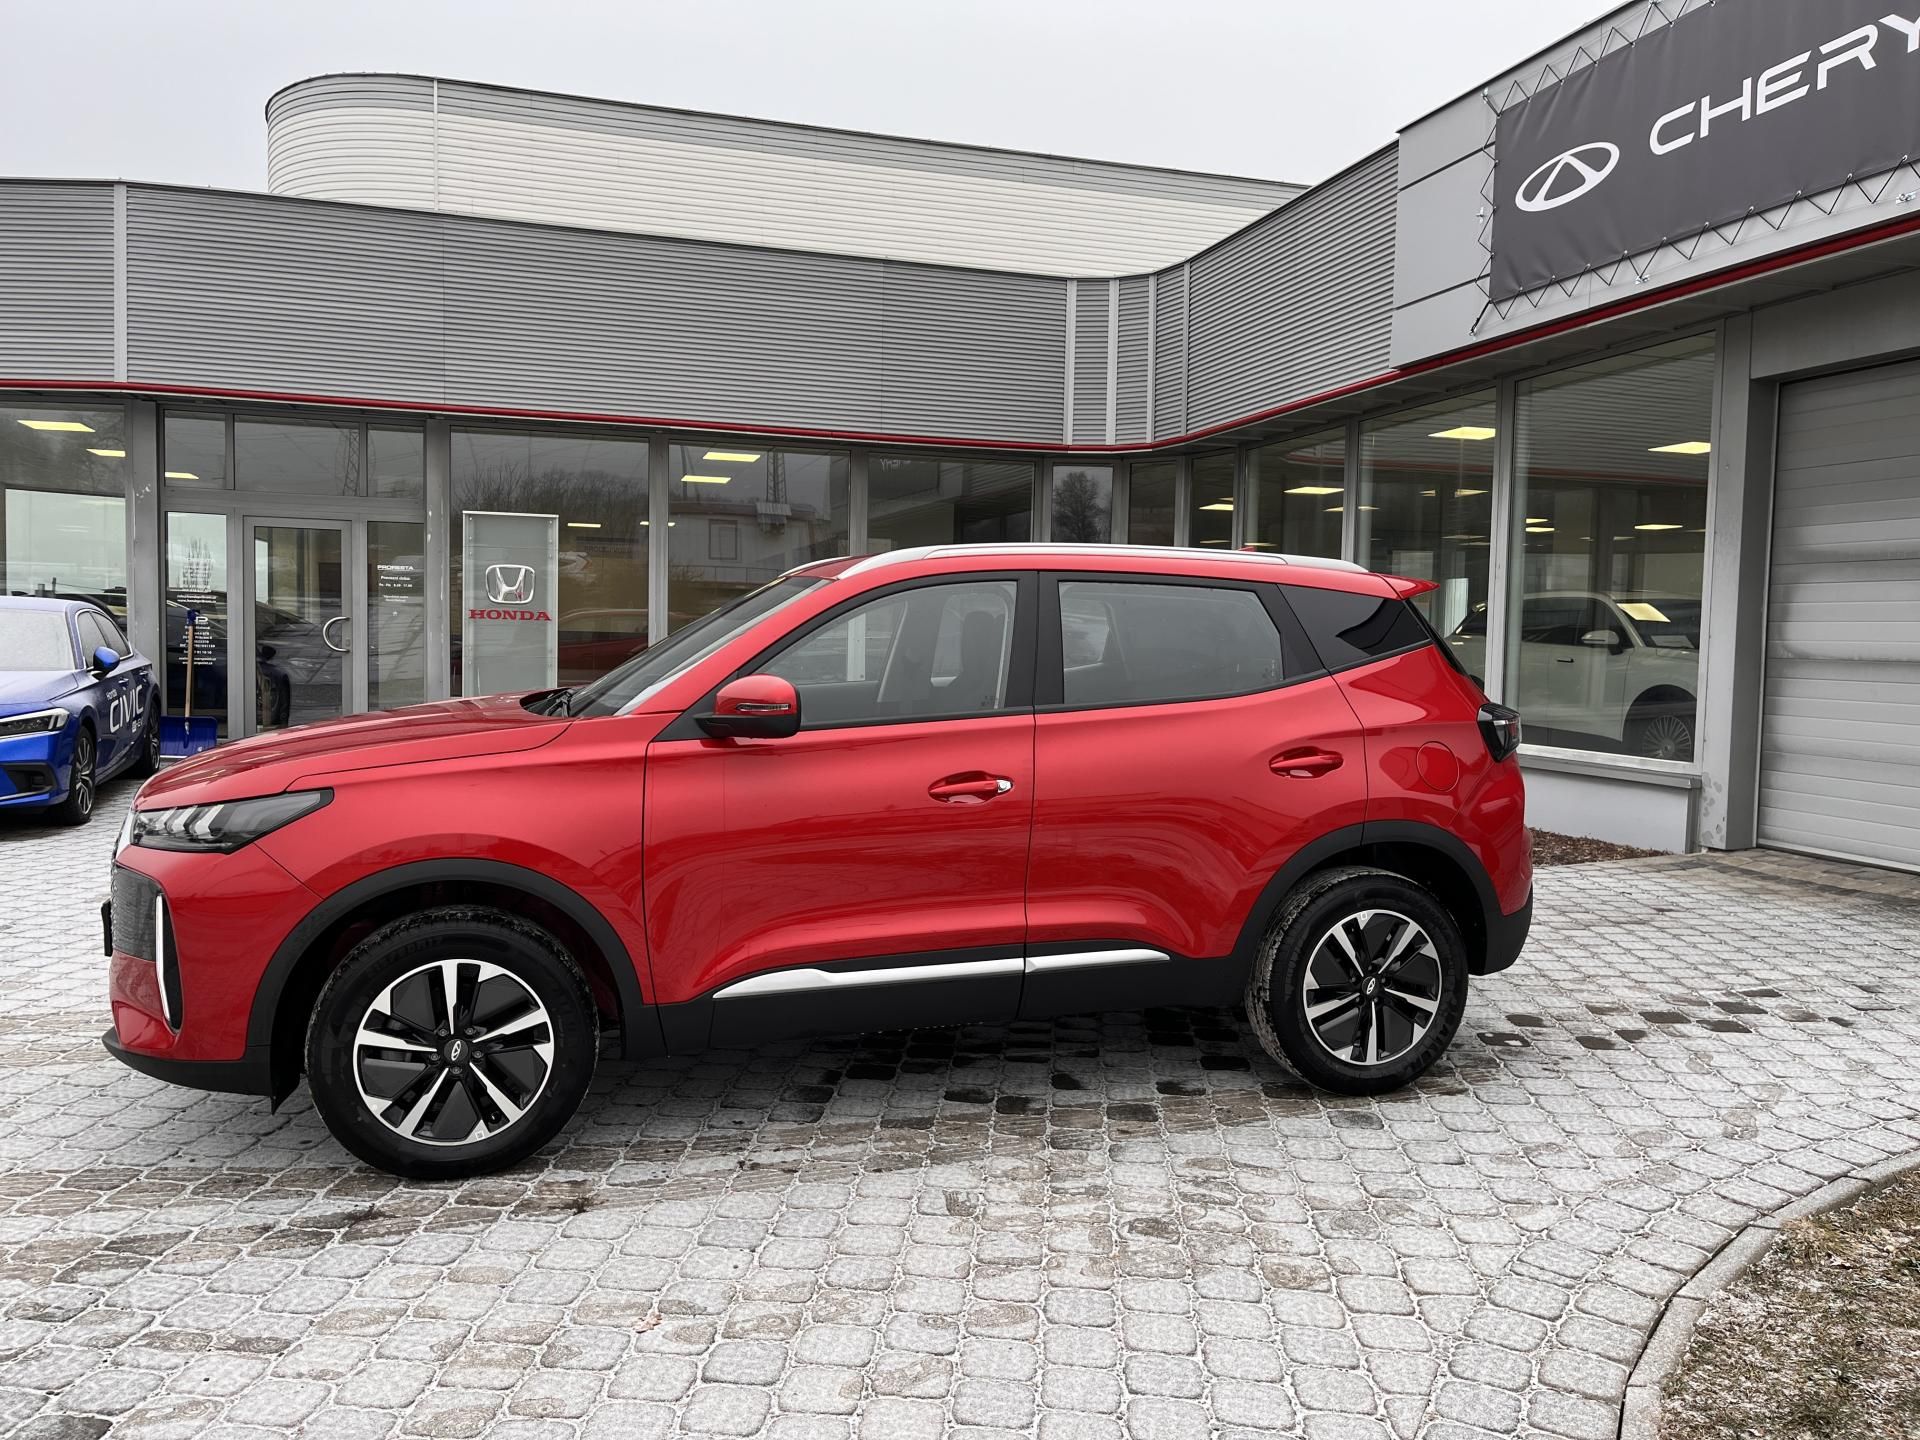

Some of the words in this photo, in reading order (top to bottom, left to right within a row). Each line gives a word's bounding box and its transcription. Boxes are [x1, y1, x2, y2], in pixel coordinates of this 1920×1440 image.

[1649, 14, 1920, 155] CHERY
[468, 609, 552, 621] HONDA
[110, 684, 144, 733] CIVIC
